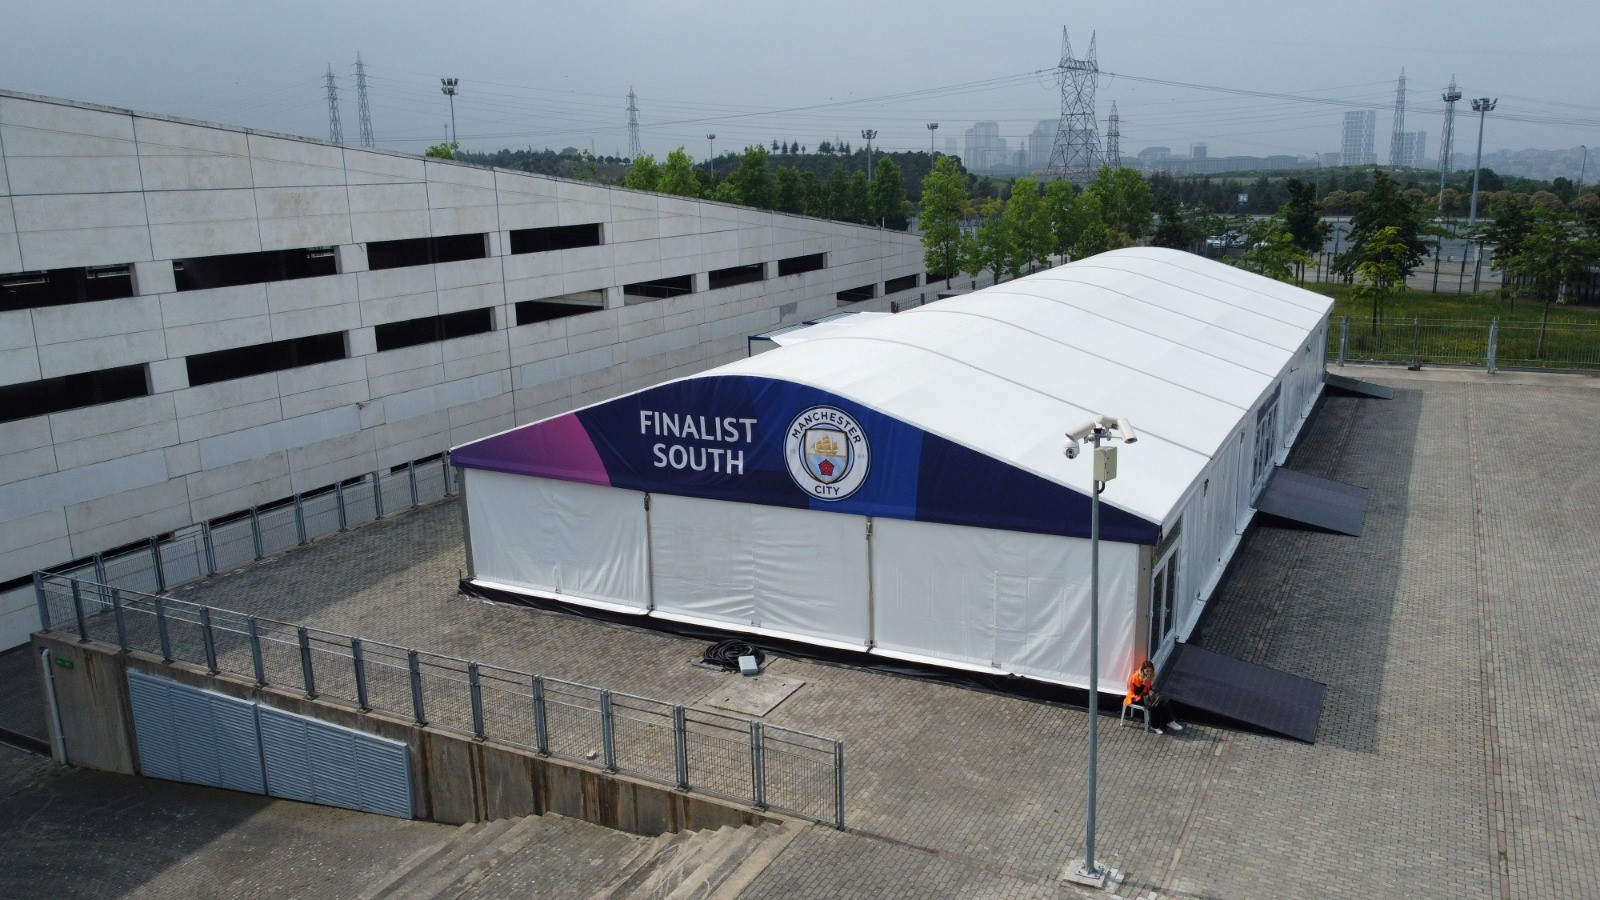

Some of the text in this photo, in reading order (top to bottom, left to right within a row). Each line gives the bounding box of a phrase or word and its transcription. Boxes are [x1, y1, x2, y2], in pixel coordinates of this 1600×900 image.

[640, 410, 757, 443] FINALIST
[792, 411, 861, 443] MANCHESTER
[653, 443, 744, 475] SOUTH
[814, 485, 840, 496] CITY
